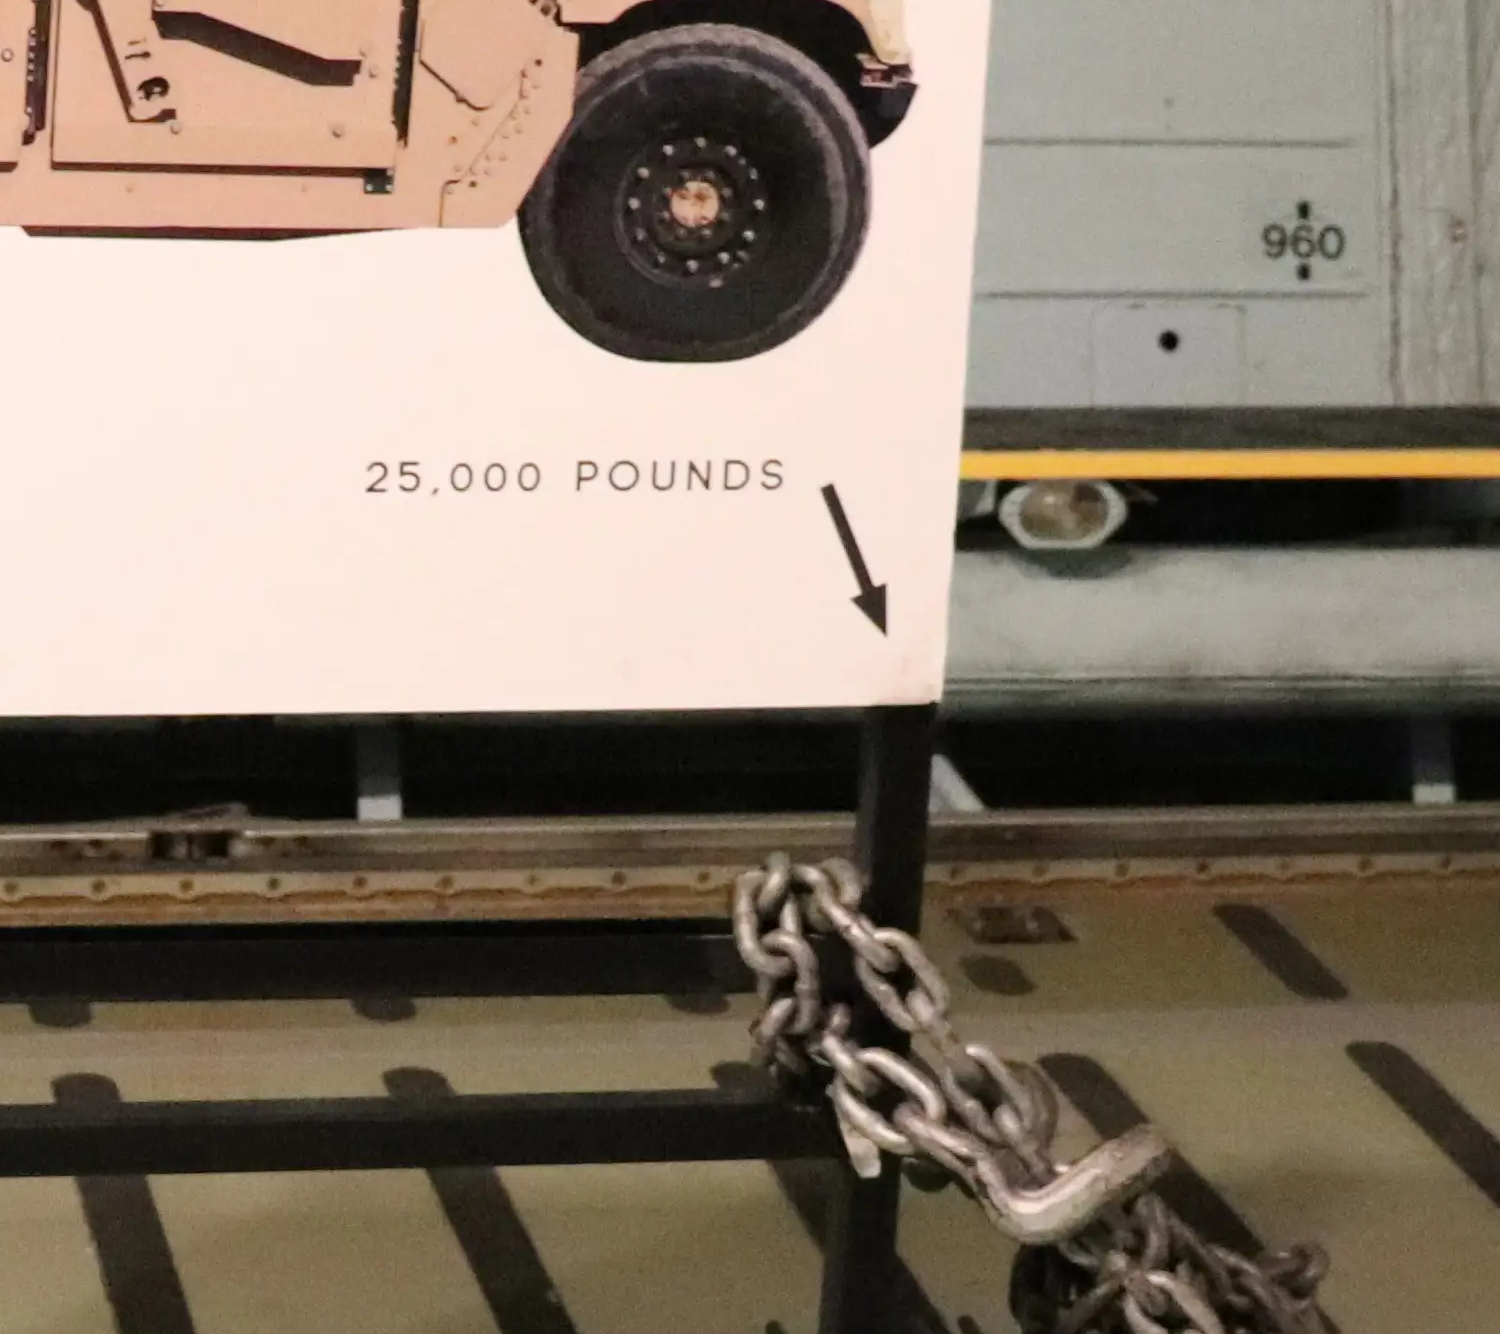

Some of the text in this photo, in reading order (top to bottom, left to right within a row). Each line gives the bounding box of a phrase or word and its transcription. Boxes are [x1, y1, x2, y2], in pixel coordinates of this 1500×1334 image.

[1262, 223, 1345, 262] 960
[365, 459, 785, 496] 25,000 POUNDS
